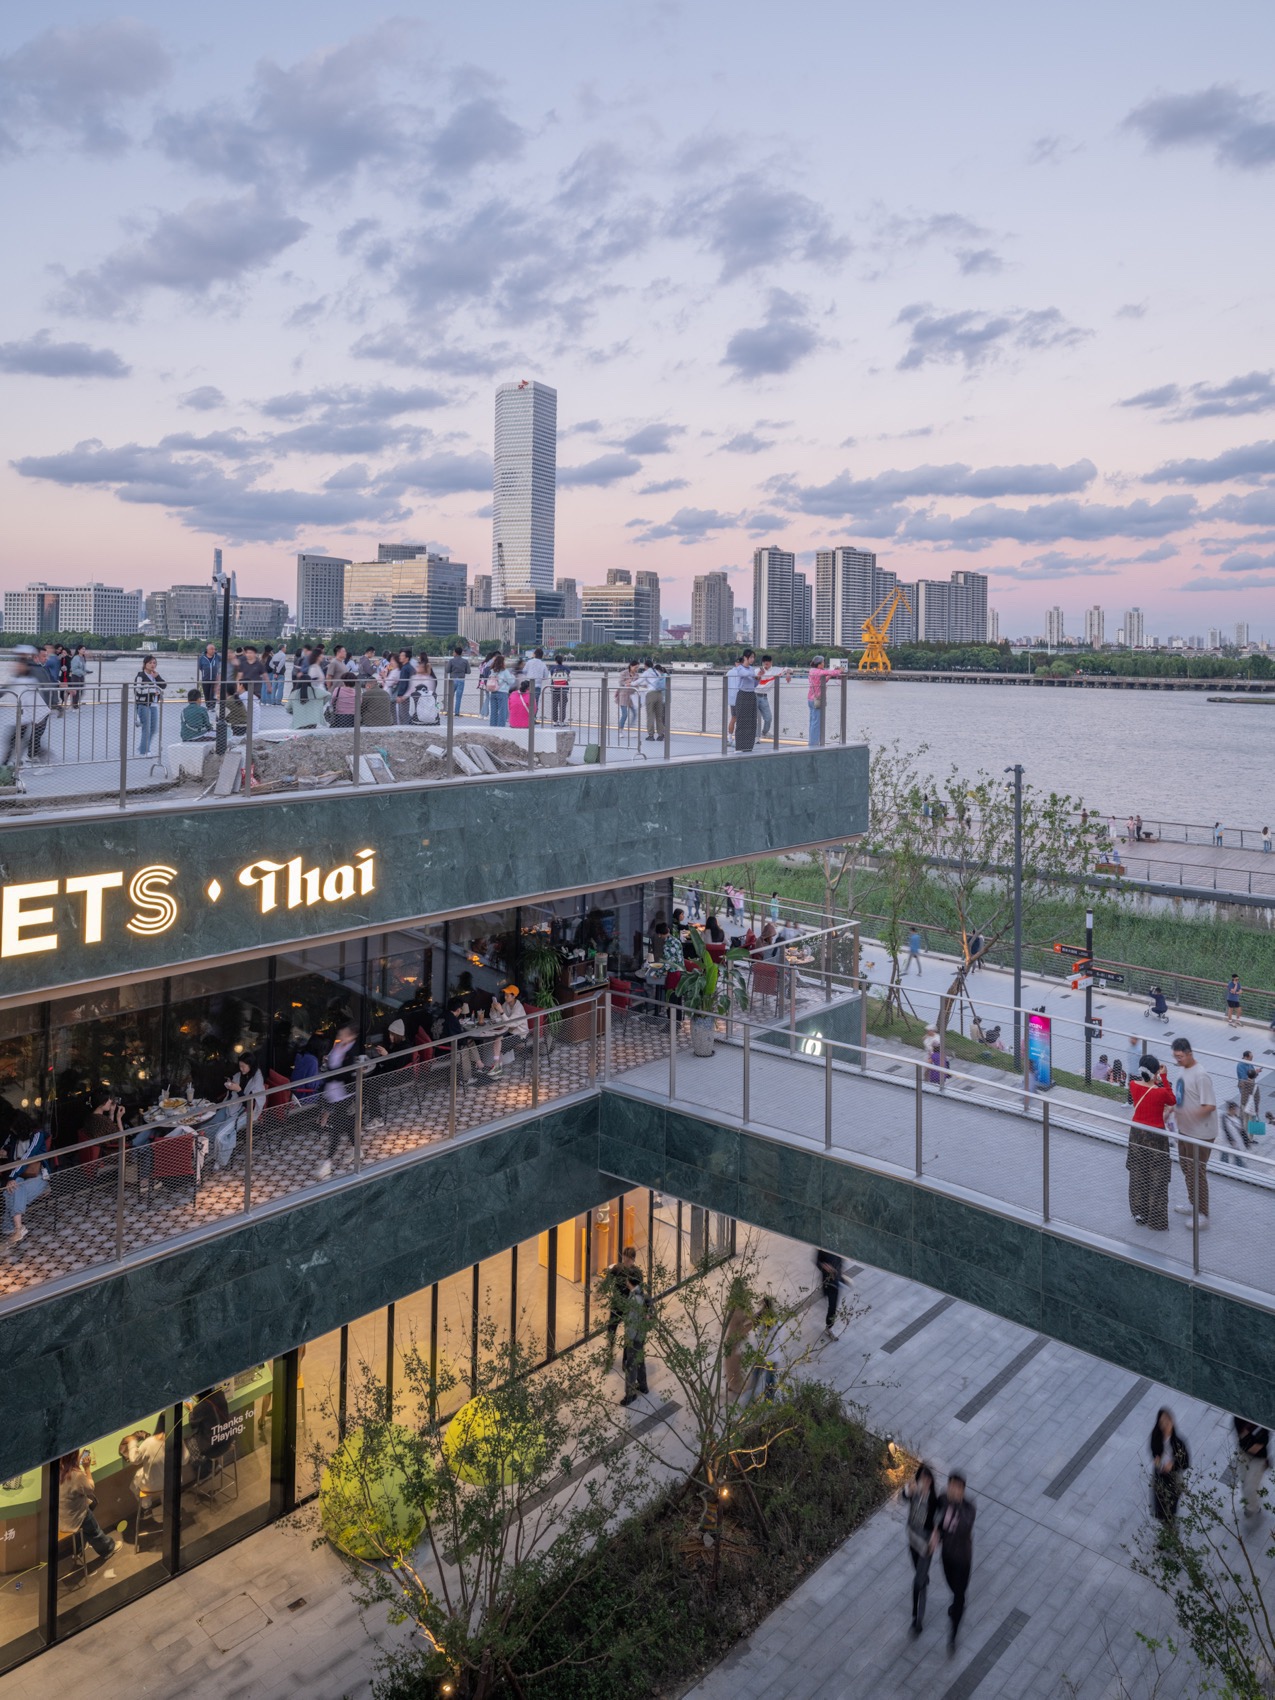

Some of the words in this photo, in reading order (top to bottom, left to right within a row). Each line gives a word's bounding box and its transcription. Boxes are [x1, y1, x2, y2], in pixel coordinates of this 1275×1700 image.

[1, 865, 178, 958] ETS
[239, 849, 376, 914] Thai
[211, 1415, 244, 1436] Thanks
[245, 1409, 257, 1420] for
[211, 1424, 246, 1446] Playing.
